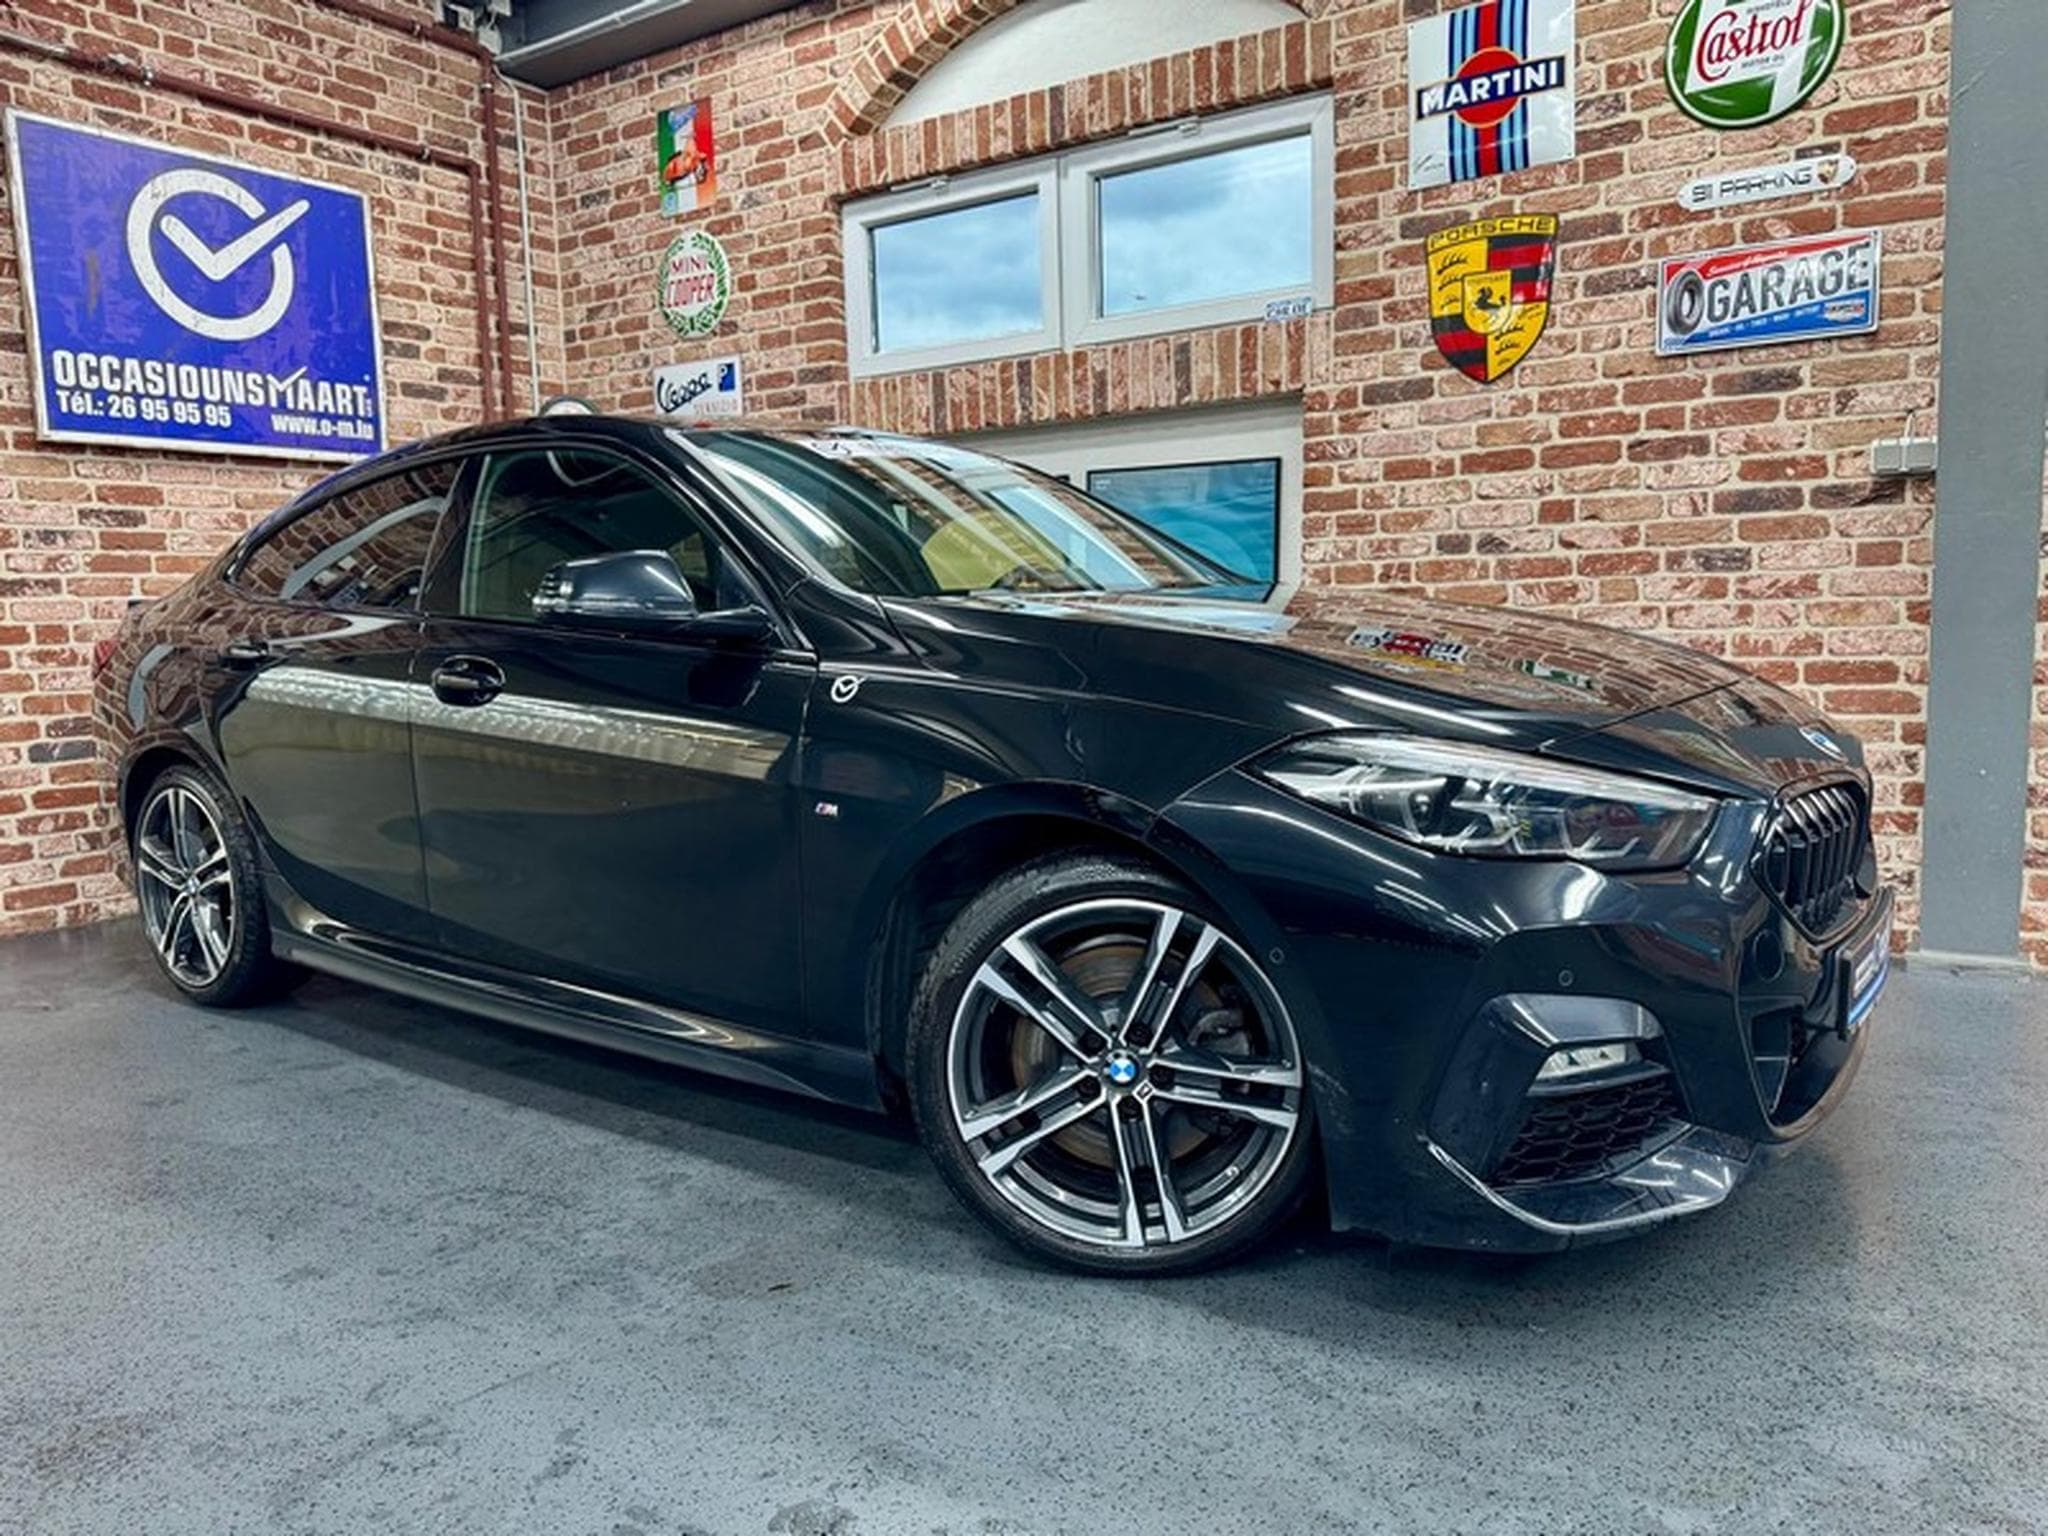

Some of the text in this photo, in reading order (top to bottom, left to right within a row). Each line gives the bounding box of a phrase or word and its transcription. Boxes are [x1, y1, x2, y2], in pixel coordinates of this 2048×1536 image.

[1696, 0, 1813, 82] Castrol
[1421, 61, 1558, 115] MARTINI
[1720, 166, 1812, 198] PARKING
[1431, 218, 1552, 248] PORSCHE
[672, 255, 715, 277] MINI
[1706, 241, 1871, 323] GARAGE
[666, 273, 715, 308] COOPER
[108, 393, 138, 419] 26
[140, 397, 168, 423] 95
[173, 401, 201, 426] 95
[205, 404, 232, 428] 95
[271, 414, 374, 440] www.o-m.lu
